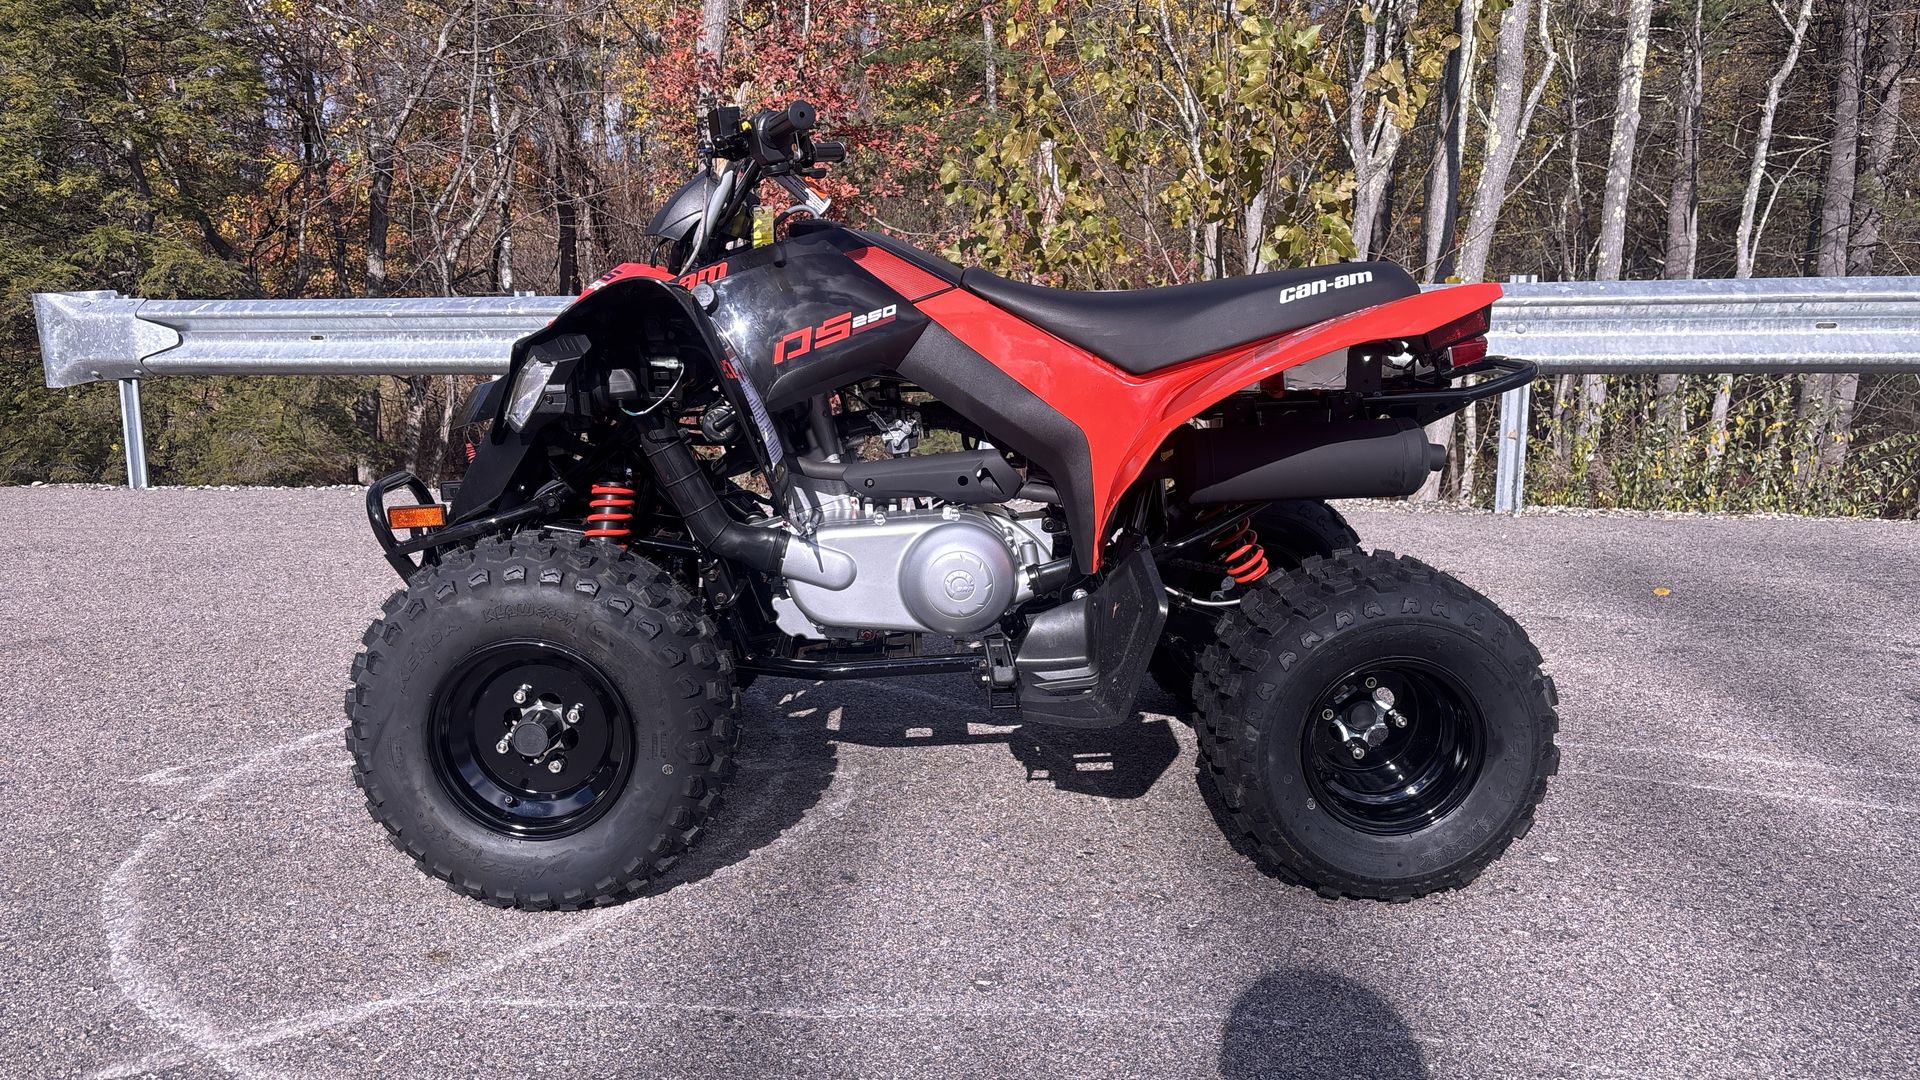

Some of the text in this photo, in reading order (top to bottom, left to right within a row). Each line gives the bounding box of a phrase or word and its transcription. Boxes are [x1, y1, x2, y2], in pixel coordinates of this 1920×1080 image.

[1280, 271, 1373, 304] can-am
[774, 304, 897, 365] DS 250
[400, 626, 463, 695] KENDA
[1497, 718, 1528, 802] KENDA
